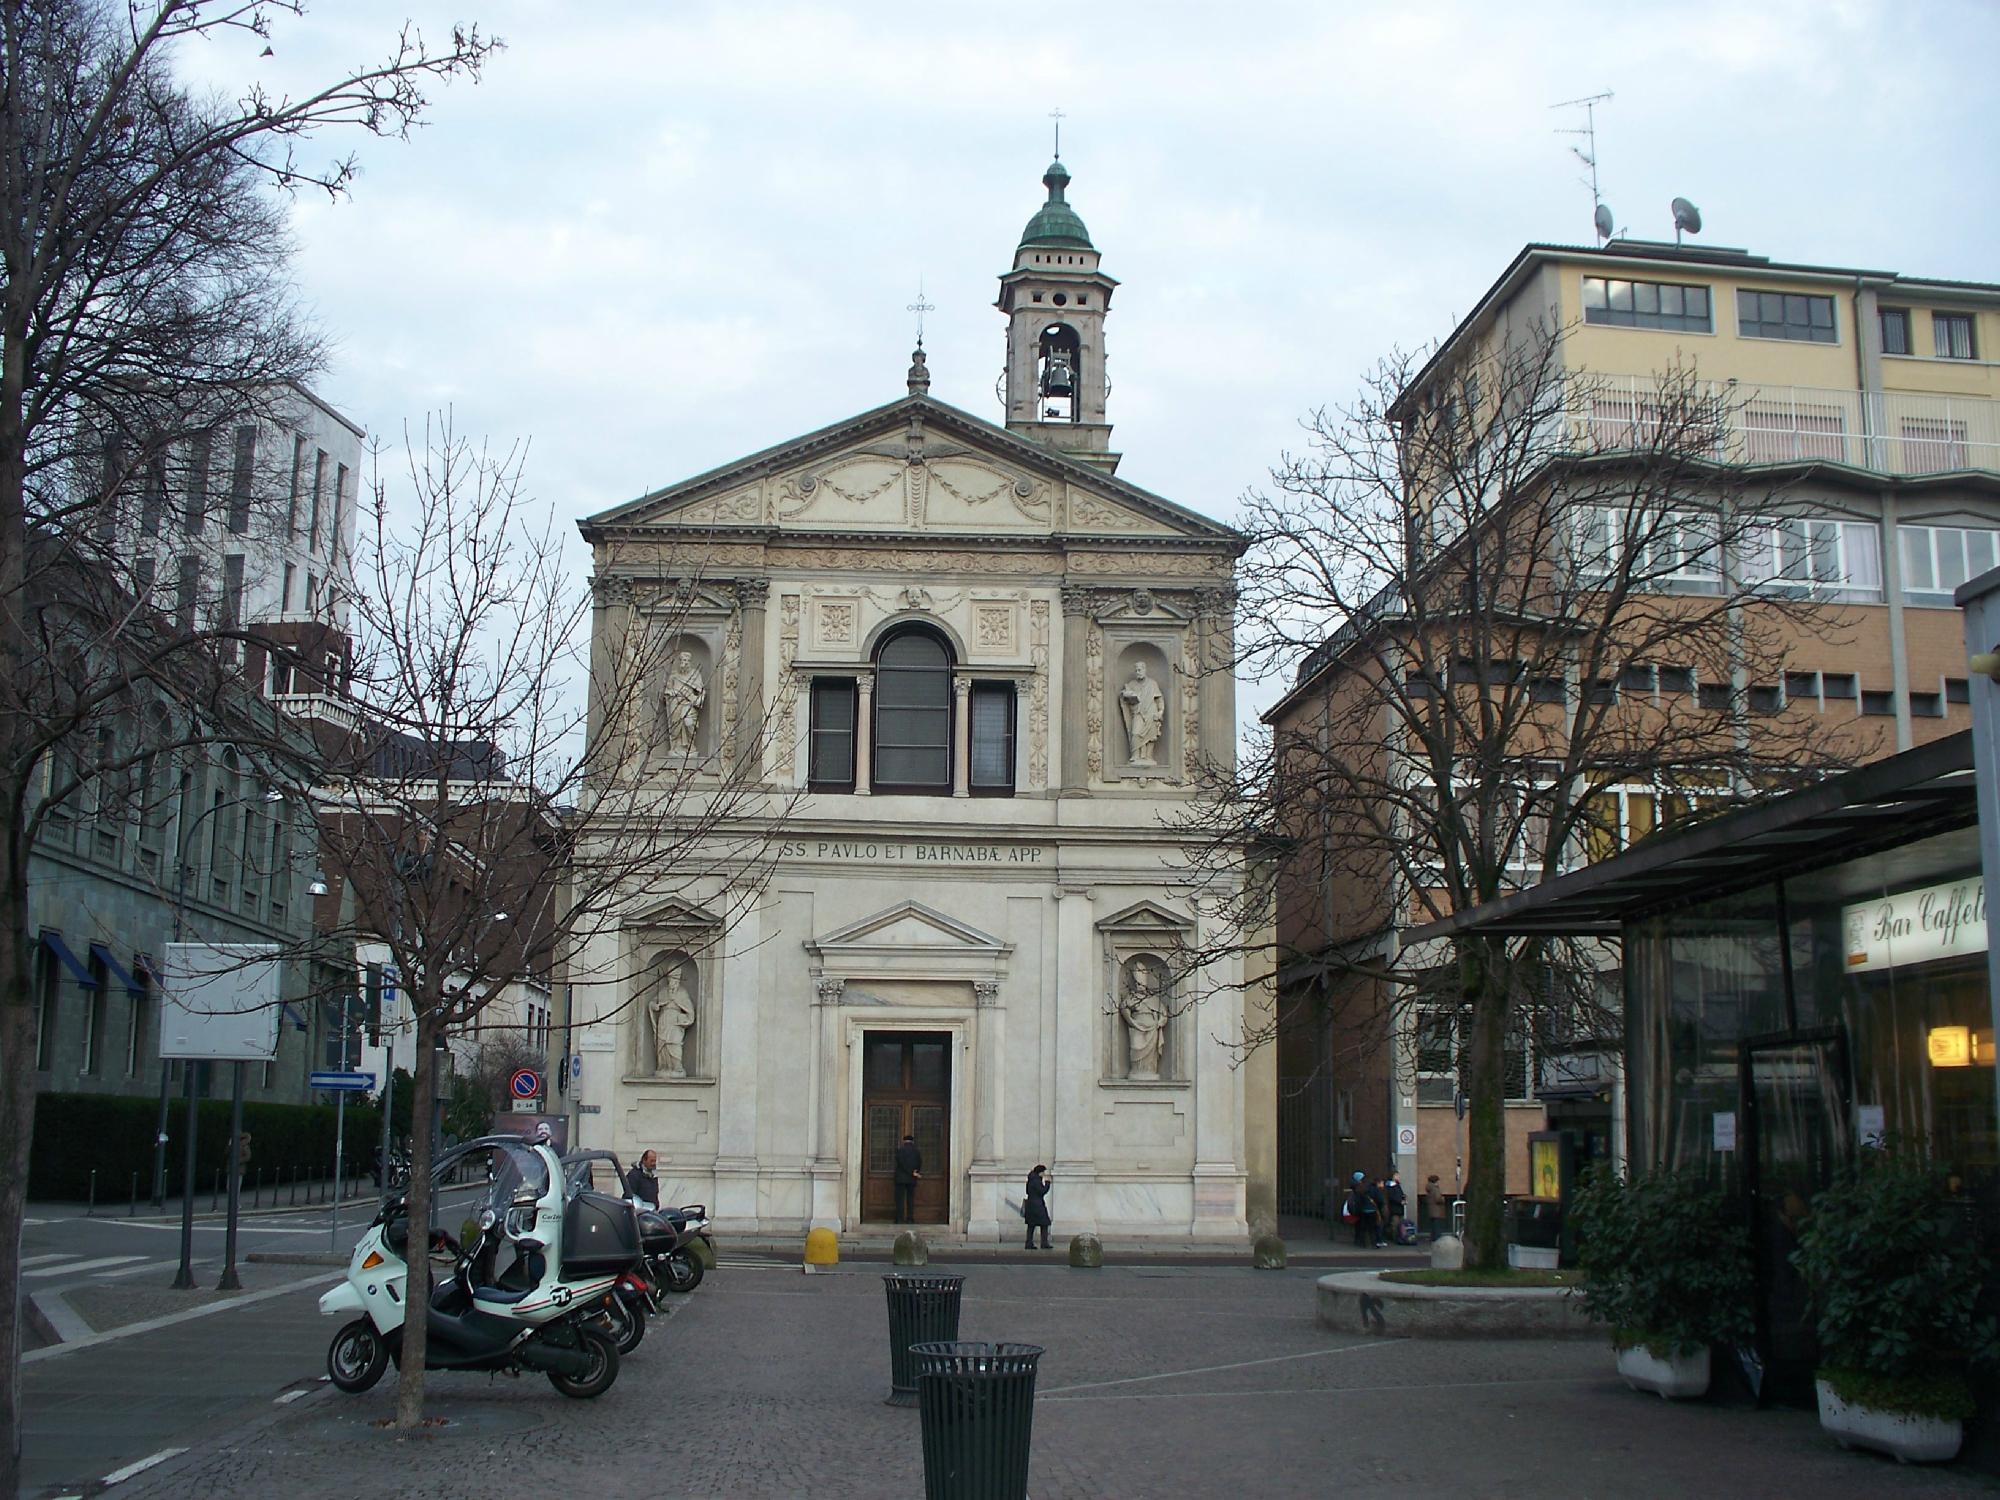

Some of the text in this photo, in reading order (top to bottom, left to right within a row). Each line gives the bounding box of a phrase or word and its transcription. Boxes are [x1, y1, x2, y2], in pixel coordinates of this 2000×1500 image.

[782, 842, 809, 857] SS.
[817, 842, 877, 859] PAVLO
[885, 844, 907, 859] ET
[916, 845, 1002, 861] BARNABÆ
[1873, 902, 1911, 941] Bar
